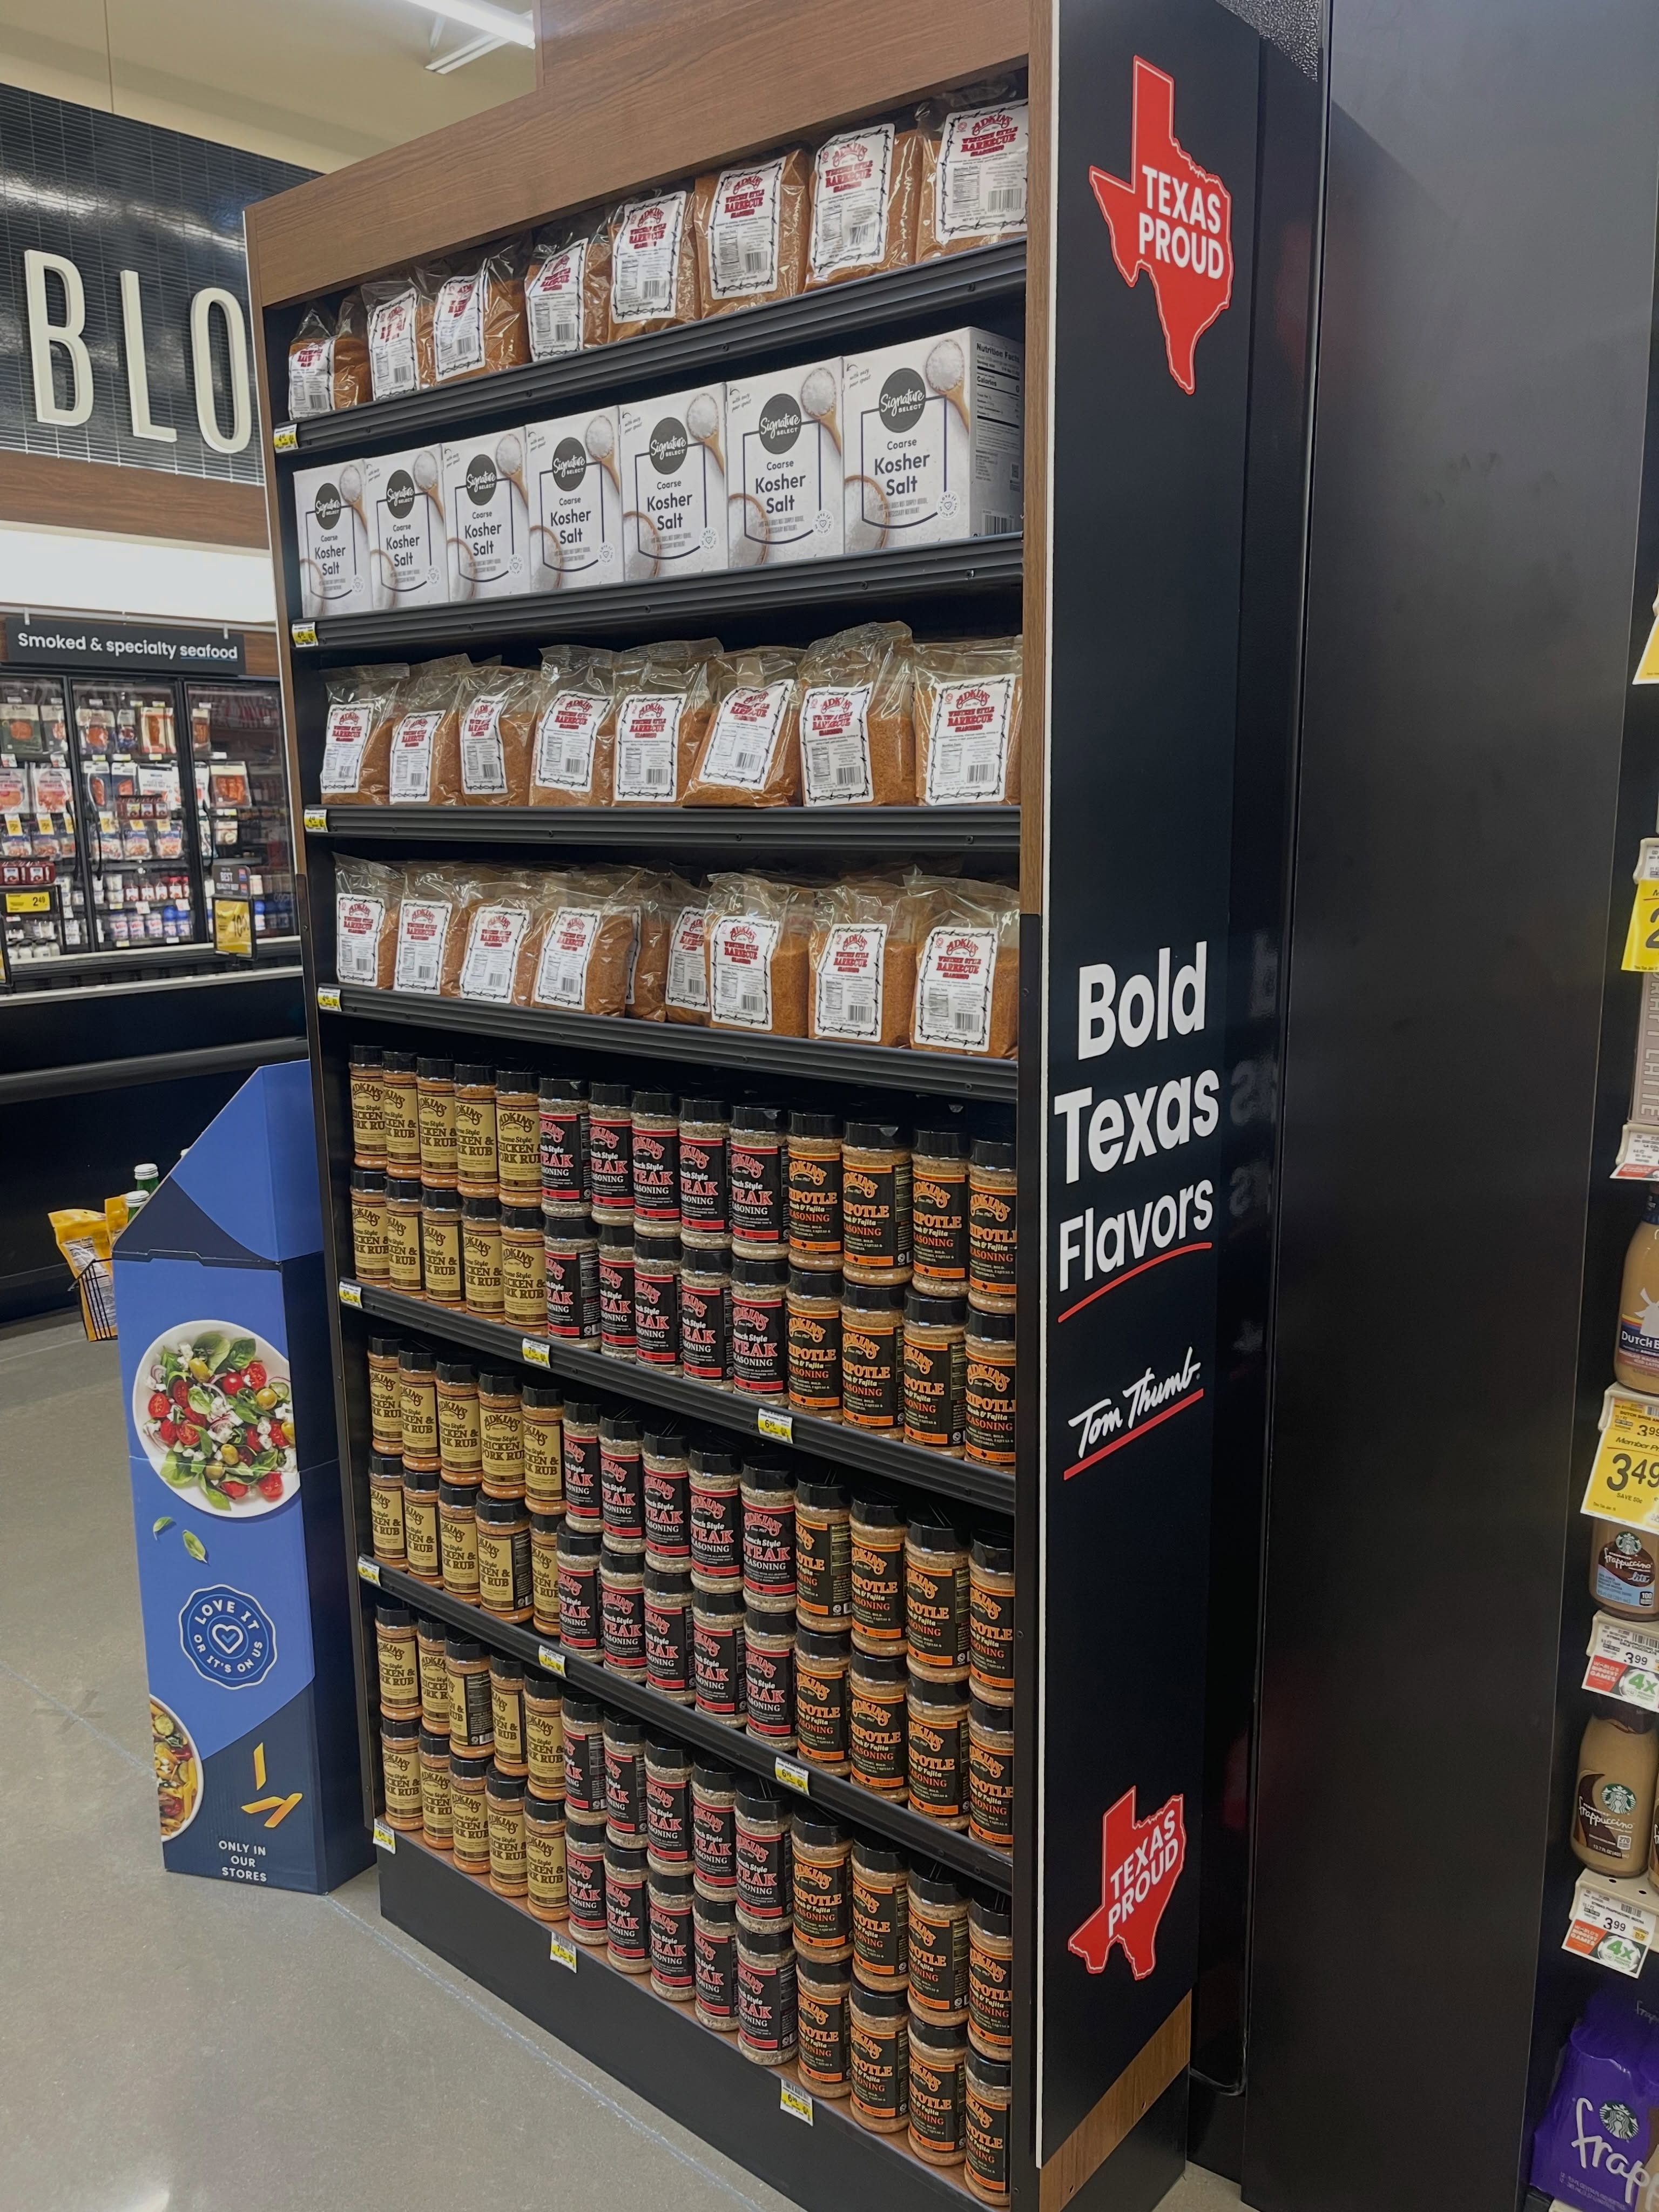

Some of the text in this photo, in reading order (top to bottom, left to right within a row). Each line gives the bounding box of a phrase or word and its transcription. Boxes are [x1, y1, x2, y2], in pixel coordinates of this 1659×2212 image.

[972, 114, 1013, 136] ADKINS
[961, 135, 1016, 153] BARBECUE
[833, 143, 868, 167] ADKINS
[825, 168, 872, 188] BARBECUE
[1142, 165, 1220, 234] TEXAS
[1139, 212, 1224, 279] PROUD
[976, 343, 1020, 363] Nutrition Facts
[977, 376, 997, 387] Calories
[880, 388, 925, 416] Signature
[898, 404, 922, 413] SELECT
[760, 414, 800, 439] Signature
[777, 427, 798, 435] SELECT
[651, 436, 686, 460] Signature
[887, 439, 917, 450] Coarse
[665, 449, 685, 457] SELECT
[553, 456, 585, 477] Signature
[766, 460, 794, 471] Coarse
[874, 453, 930, 475] Kosher
[467, 472, 496, 493] Signature
[657, 480, 681, 490] Coarse
[756, 474, 806, 494] Kosher
[886, 476, 918, 496] Salt
[387, 483, 414, 504] Signature
[315, 497, 341, 516] Signature
[559, 497, 581, 506] Coarse
[648, 493, 692, 512] Kosher
[766, 495, 794, 514] Salt
[472, 510, 492, 520] Coarse
[551, 509, 591, 527] Kosher
[657, 513, 683, 531] Salt
[393, 524, 411, 532] Coarse
[465, 523, 502, 539] Kosher
[321, 534, 338, 542] Coarse
[386, 534, 420, 550] Kosher
[559, 528, 582, 545] Salt
[315, 545, 346, 560] Kosher
[473, 542, 494, 556] Salt
[394, 554, 413, 567] Salt
[322, 563, 340, 576] Salt
[18, 632, 238, 659] Smoked & specialty seafood
[956, 689, 990, 708] ADKINS
[976, 706, 995, 714] STYLE
[947, 713, 993, 727] BARBECUE
[731, 927, 757, 944] ADKINS
[724, 949, 758, 961] BARBECUE
[947, 939, 980, 956] ADKINS
[833, 957, 867, 968] BARBECUE
[936, 962, 979, 975] BARBECUE
[1078, 941, 1208, 1060] Bold
[499, 1112, 535, 1132] ADKINS
[1054, 1069, 1219, 1184] Texas
[395, 1129, 415, 1138] RUB
[484, 1137, 494, 1145] &
[471, 1146, 493, 1156] RUB
[646, 1163, 664, 1172] Style
[789, 1161, 827, 1185] ADKINS
[745, 1182, 763, 1190] Style
[806, 1205, 825, 1213] Fajita
[858, 1218, 876, 1226] Fajita
[1060, 1179, 1213, 1292] Flavors
[988, 1243, 1008, 1251] Fajita
[478, 1277, 501, 1287] RUB
[520, 1290, 544, 1299] RUB
[749, 1334, 767, 1344] Style
[967, 1364, 1010, 1392] ADKINS
[1068, 1346, 1201, 1458] Tom Thumb
[484, 1414, 520, 1432] ADKINS
[987, 1412, 1008, 1421] Fajita
[455, 1438, 477, 1448] RUB
[1616, 1437, 1650, 1449] Member
[1607, 1453, 1659, 1492] 349
[1617, 1492, 1632, 1501] SAVE
[657, 1502, 674, 1511] Style
[762, 1539, 781, 1548] Style
[487, 1577, 509, 1587] RUB
[194, 1599, 260, 1631] LOVE IT
[193, 1634, 264, 1674] OR IT'S ON US
[1624, 1653, 1648, 1665] 399
[393, 1676, 414, 1685] RUB
[541, 1755, 563, 1764] RUB
[218, 1840, 266, 1856] ONLY IN
[1110, 1810, 1175, 1899] TEXAS
[231, 1854, 256, 1868] OUR
[221, 1866, 267, 1883] STORES
[751, 1865, 767, 1874] Style
[542, 1873, 564, 1884] RUB
[1108, 1838, 1178, 1938] PROUD
[1603, 1917, 1626, 1932] 399
